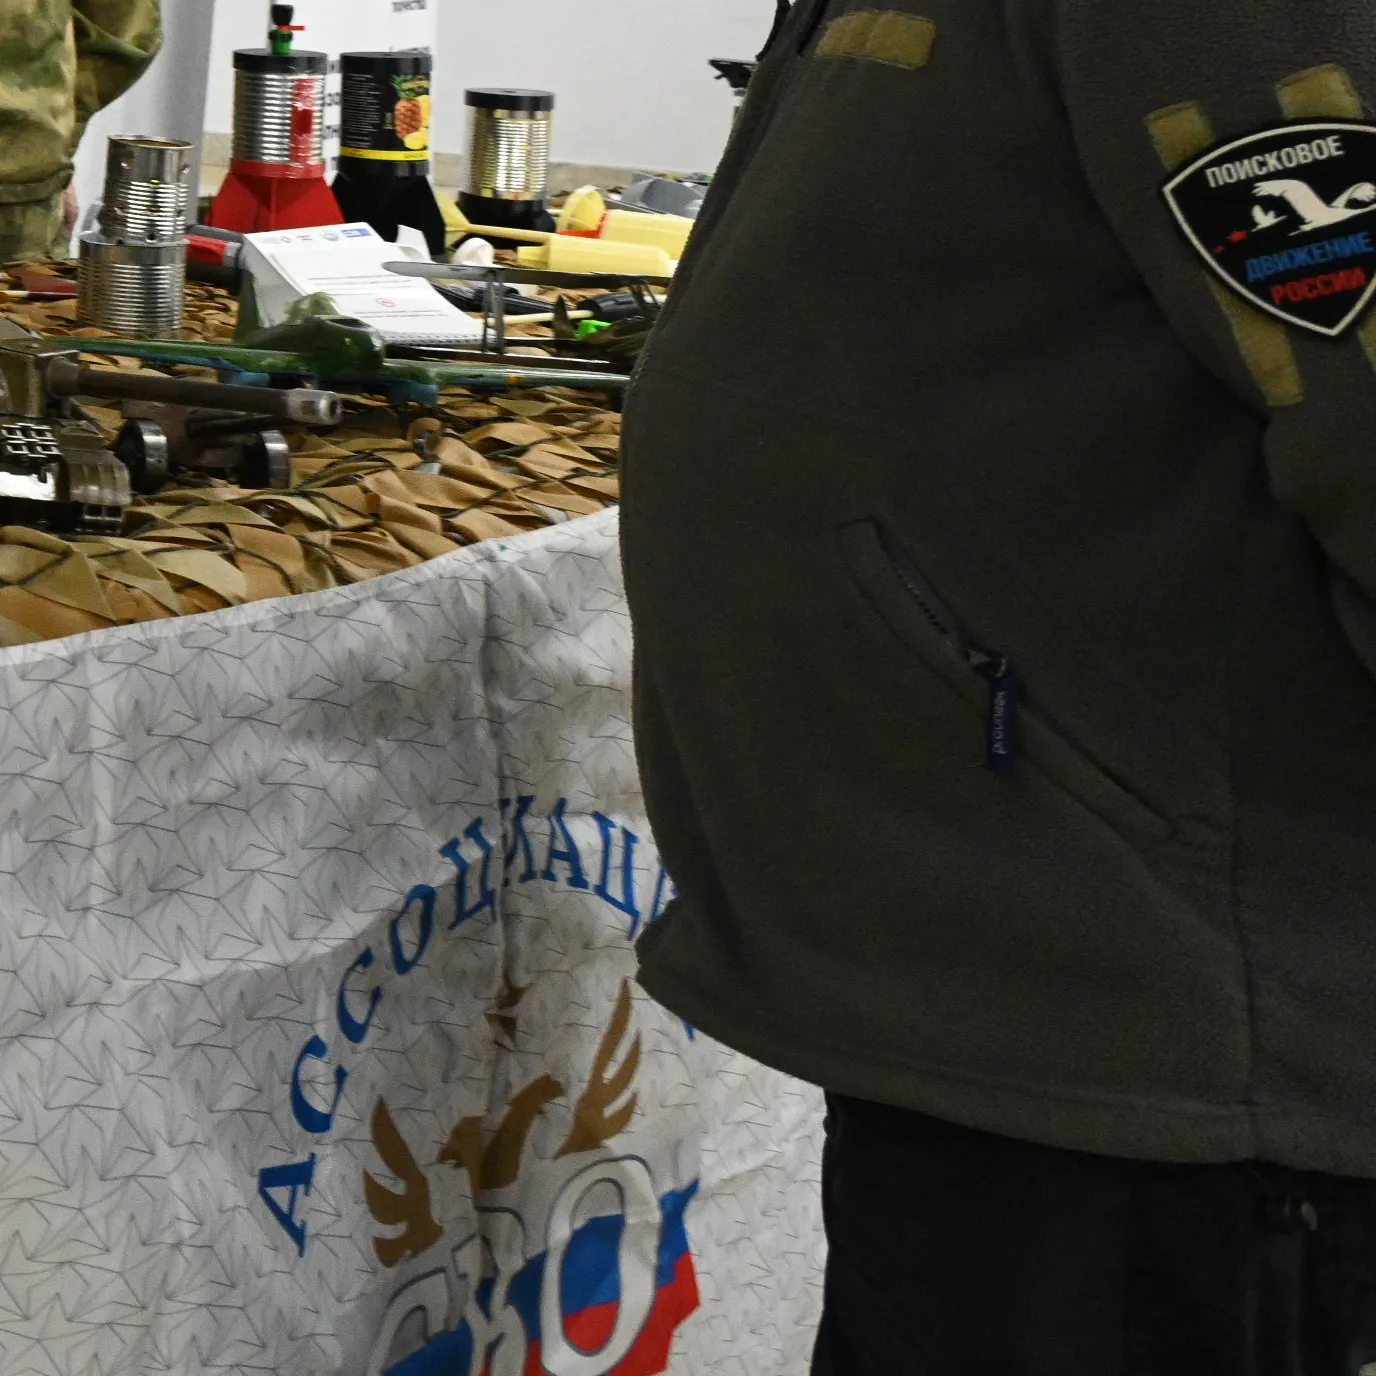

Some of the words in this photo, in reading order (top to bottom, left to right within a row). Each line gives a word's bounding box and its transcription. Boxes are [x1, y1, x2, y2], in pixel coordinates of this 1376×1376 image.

[1205, 135, 1345, 188] ПОИСКОВОЕ
[1244, 231, 1374, 282] ДВИЖЕНИЕ
[1271, 267, 1366, 304] РОССИИ
